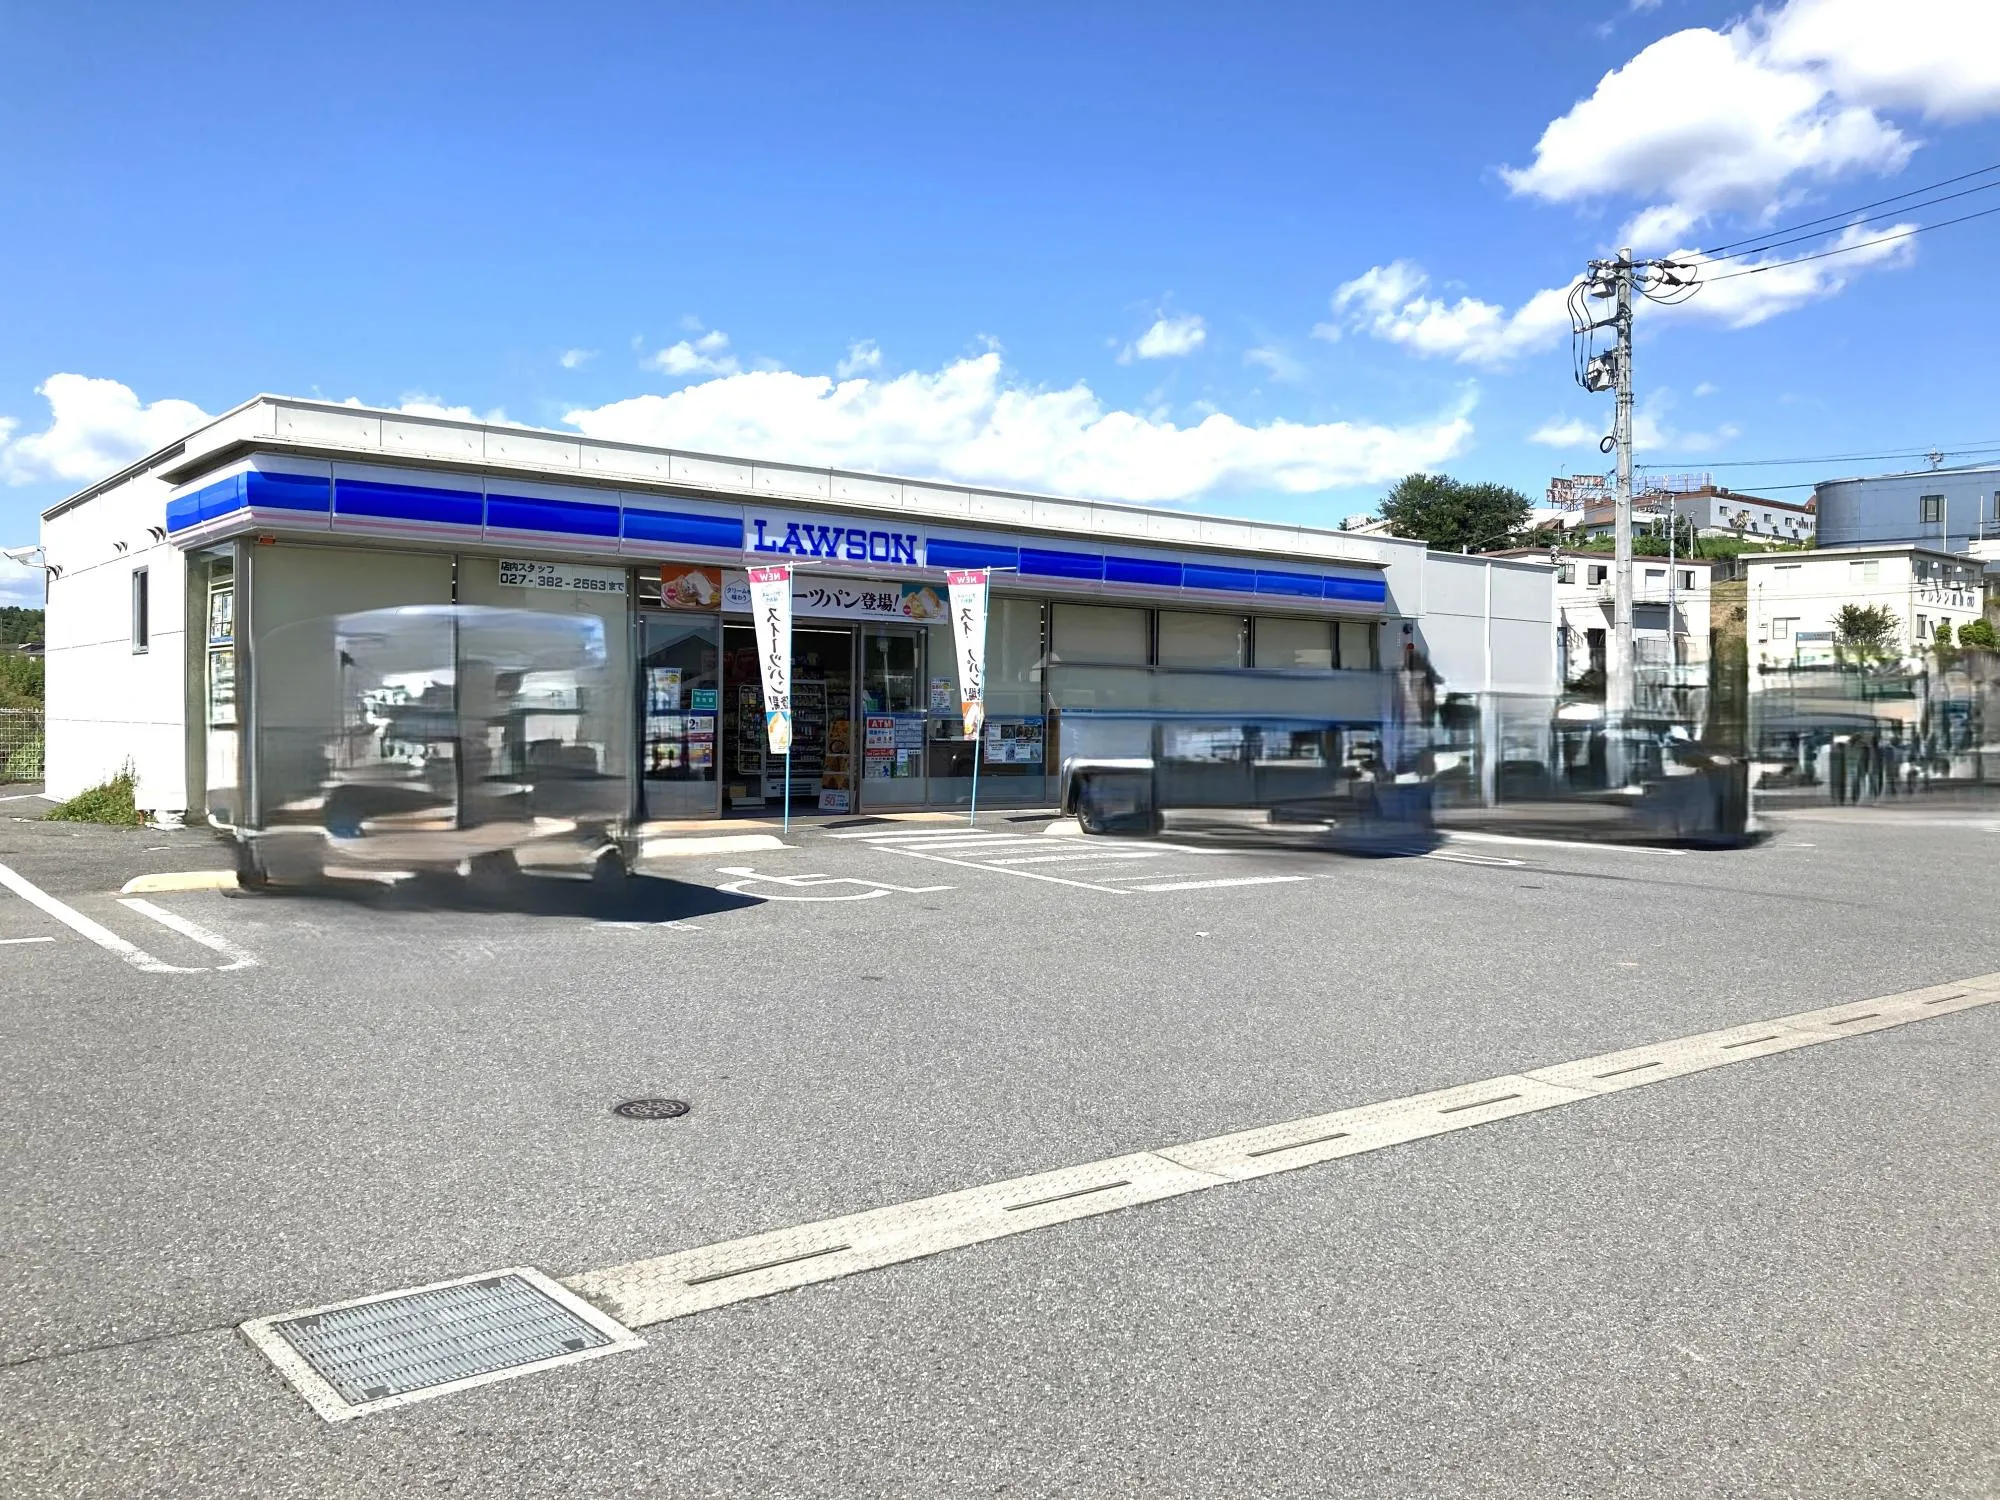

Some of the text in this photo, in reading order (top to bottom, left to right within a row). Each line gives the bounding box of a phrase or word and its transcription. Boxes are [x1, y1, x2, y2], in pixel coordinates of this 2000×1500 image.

[753, 519, 918, 565] LAWSON
[500, 560, 555, 574] 店内スタッフ
[871, 719, 892, 728] ATM
